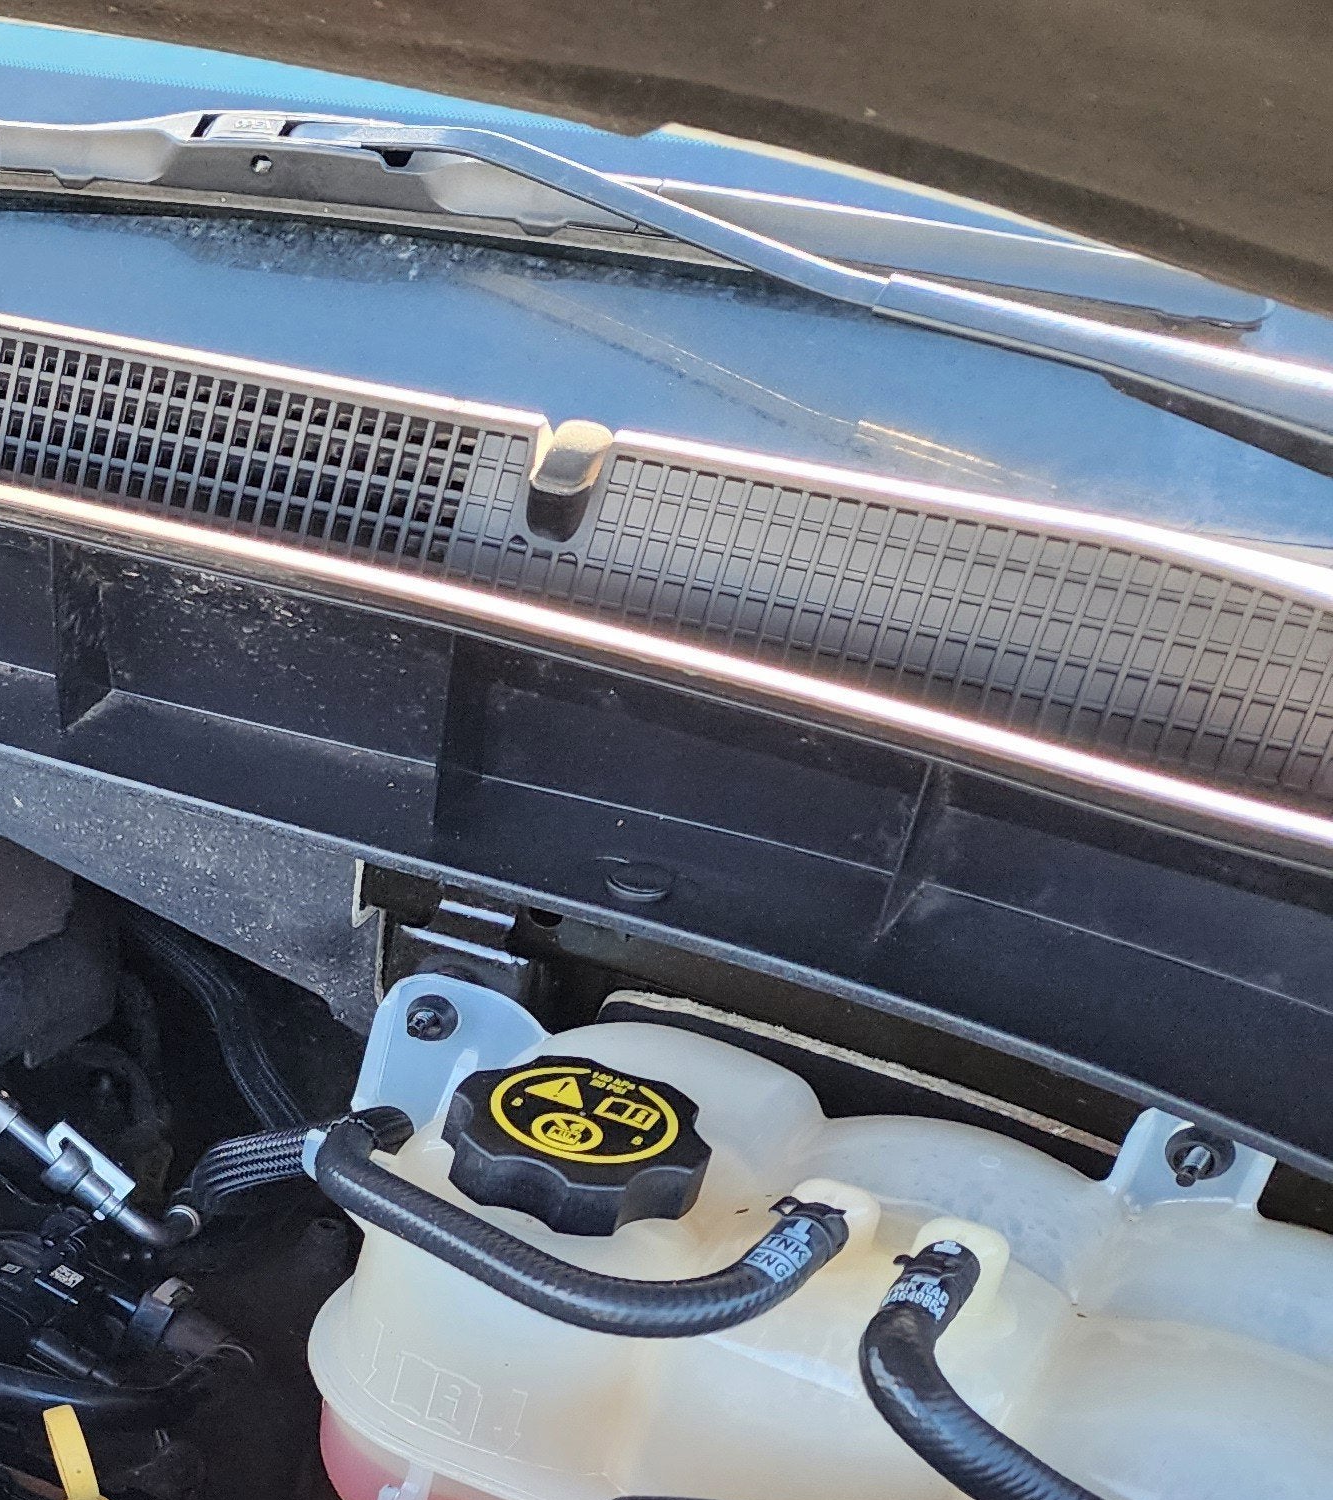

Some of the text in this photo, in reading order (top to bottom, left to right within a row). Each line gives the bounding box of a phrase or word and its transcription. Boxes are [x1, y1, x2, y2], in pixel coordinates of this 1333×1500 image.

[765, 1235, 808, 1263] TNK
[749, 1250, 792, 1279] ENG
[920, 1283, 950, 1307] RAD
